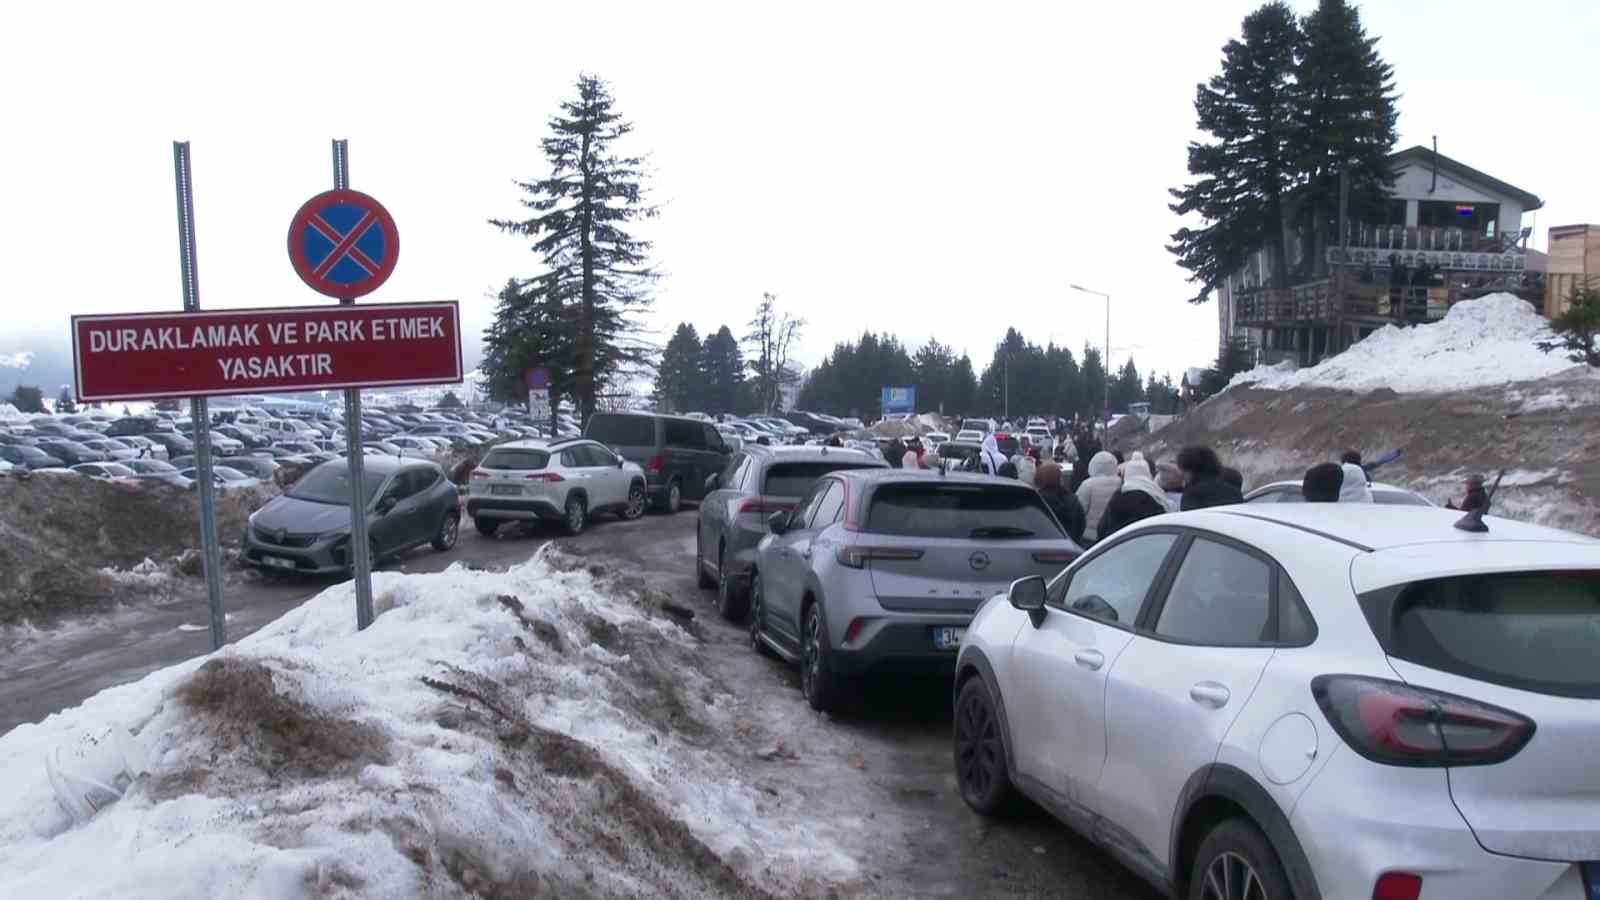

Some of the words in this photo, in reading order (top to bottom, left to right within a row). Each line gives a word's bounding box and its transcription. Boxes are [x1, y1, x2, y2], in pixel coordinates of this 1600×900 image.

[89, 324, 260, 353] DURAKLAMAK
[267, 322, 297, 345] VE
[304, 320, 365, 343] PARK
[372, 316, 444, 341] ETMEK
[218, 353, 333, 381] YASAKTIR
